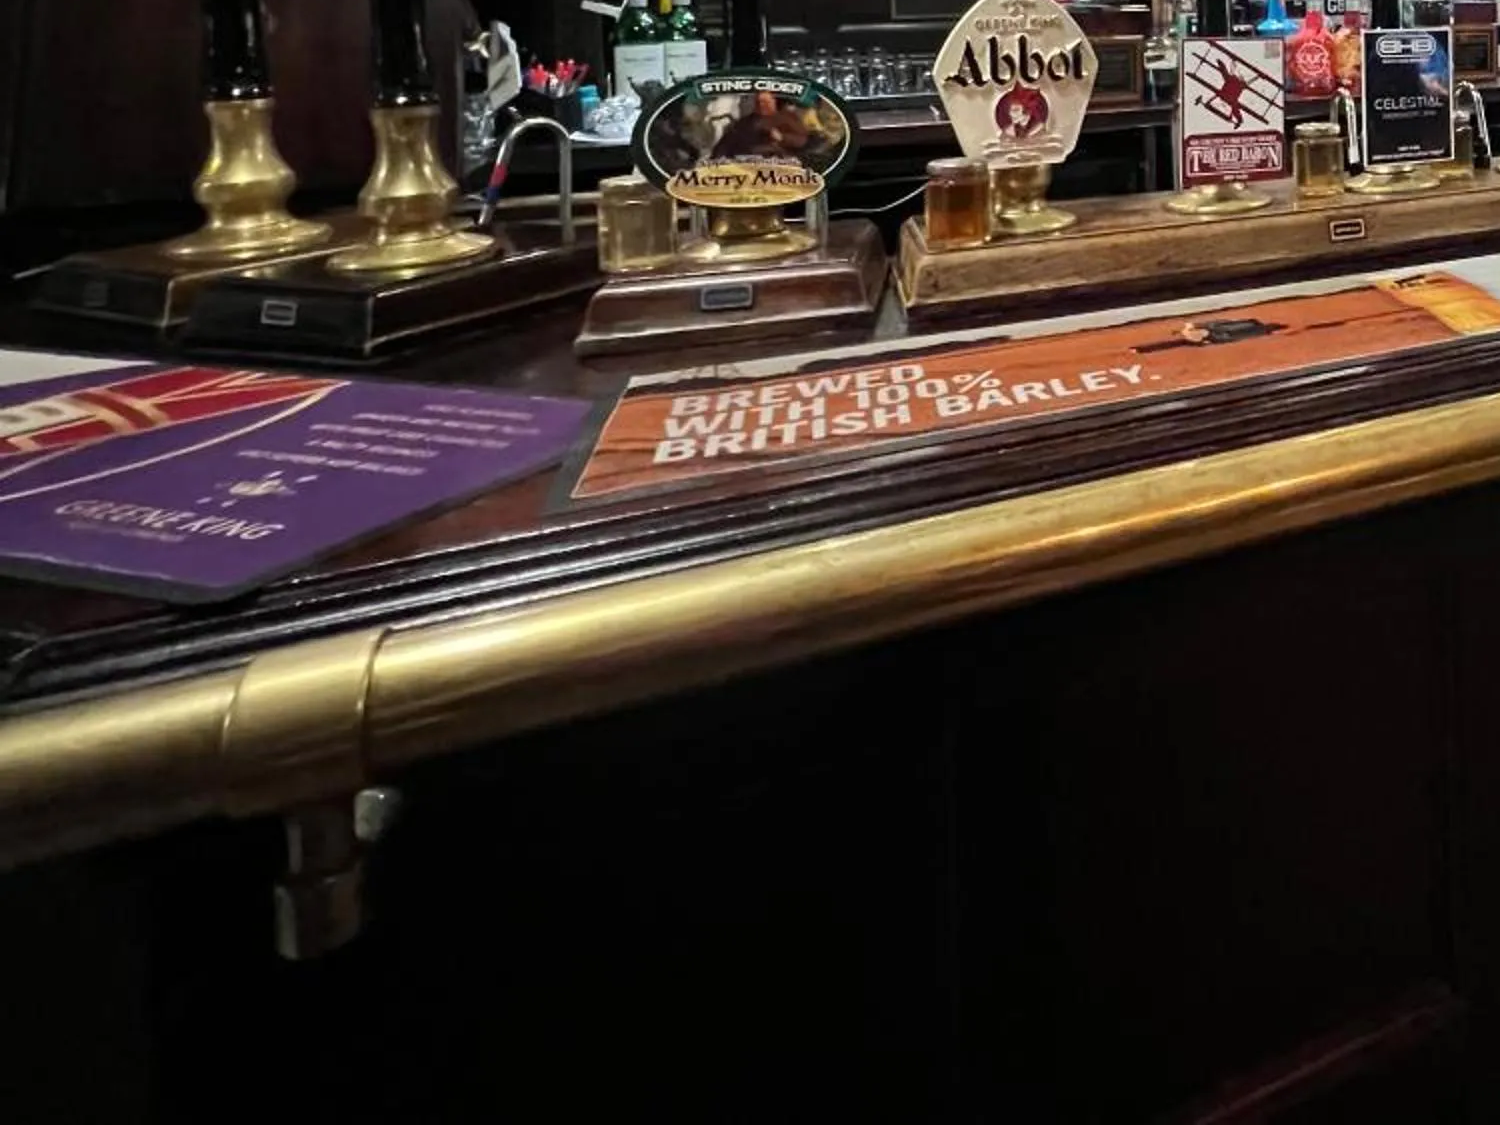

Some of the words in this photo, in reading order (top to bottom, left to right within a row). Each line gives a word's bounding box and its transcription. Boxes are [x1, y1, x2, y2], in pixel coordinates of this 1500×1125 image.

[754, 80, 805, 94] CIDER
[944, 33, 1084, 87] Abbot
[1374, 95, 1444, 110] CELESTIAL
[675, 169, 745, 190] Merry
[753, 168, 818, 186] Monk
[664, 396, 826, 440] WITH
[854, 368, 1001, 412] 100%
[672, 363, 926, 418] BREWED
[653, 408, 913, 466] BRITISH
